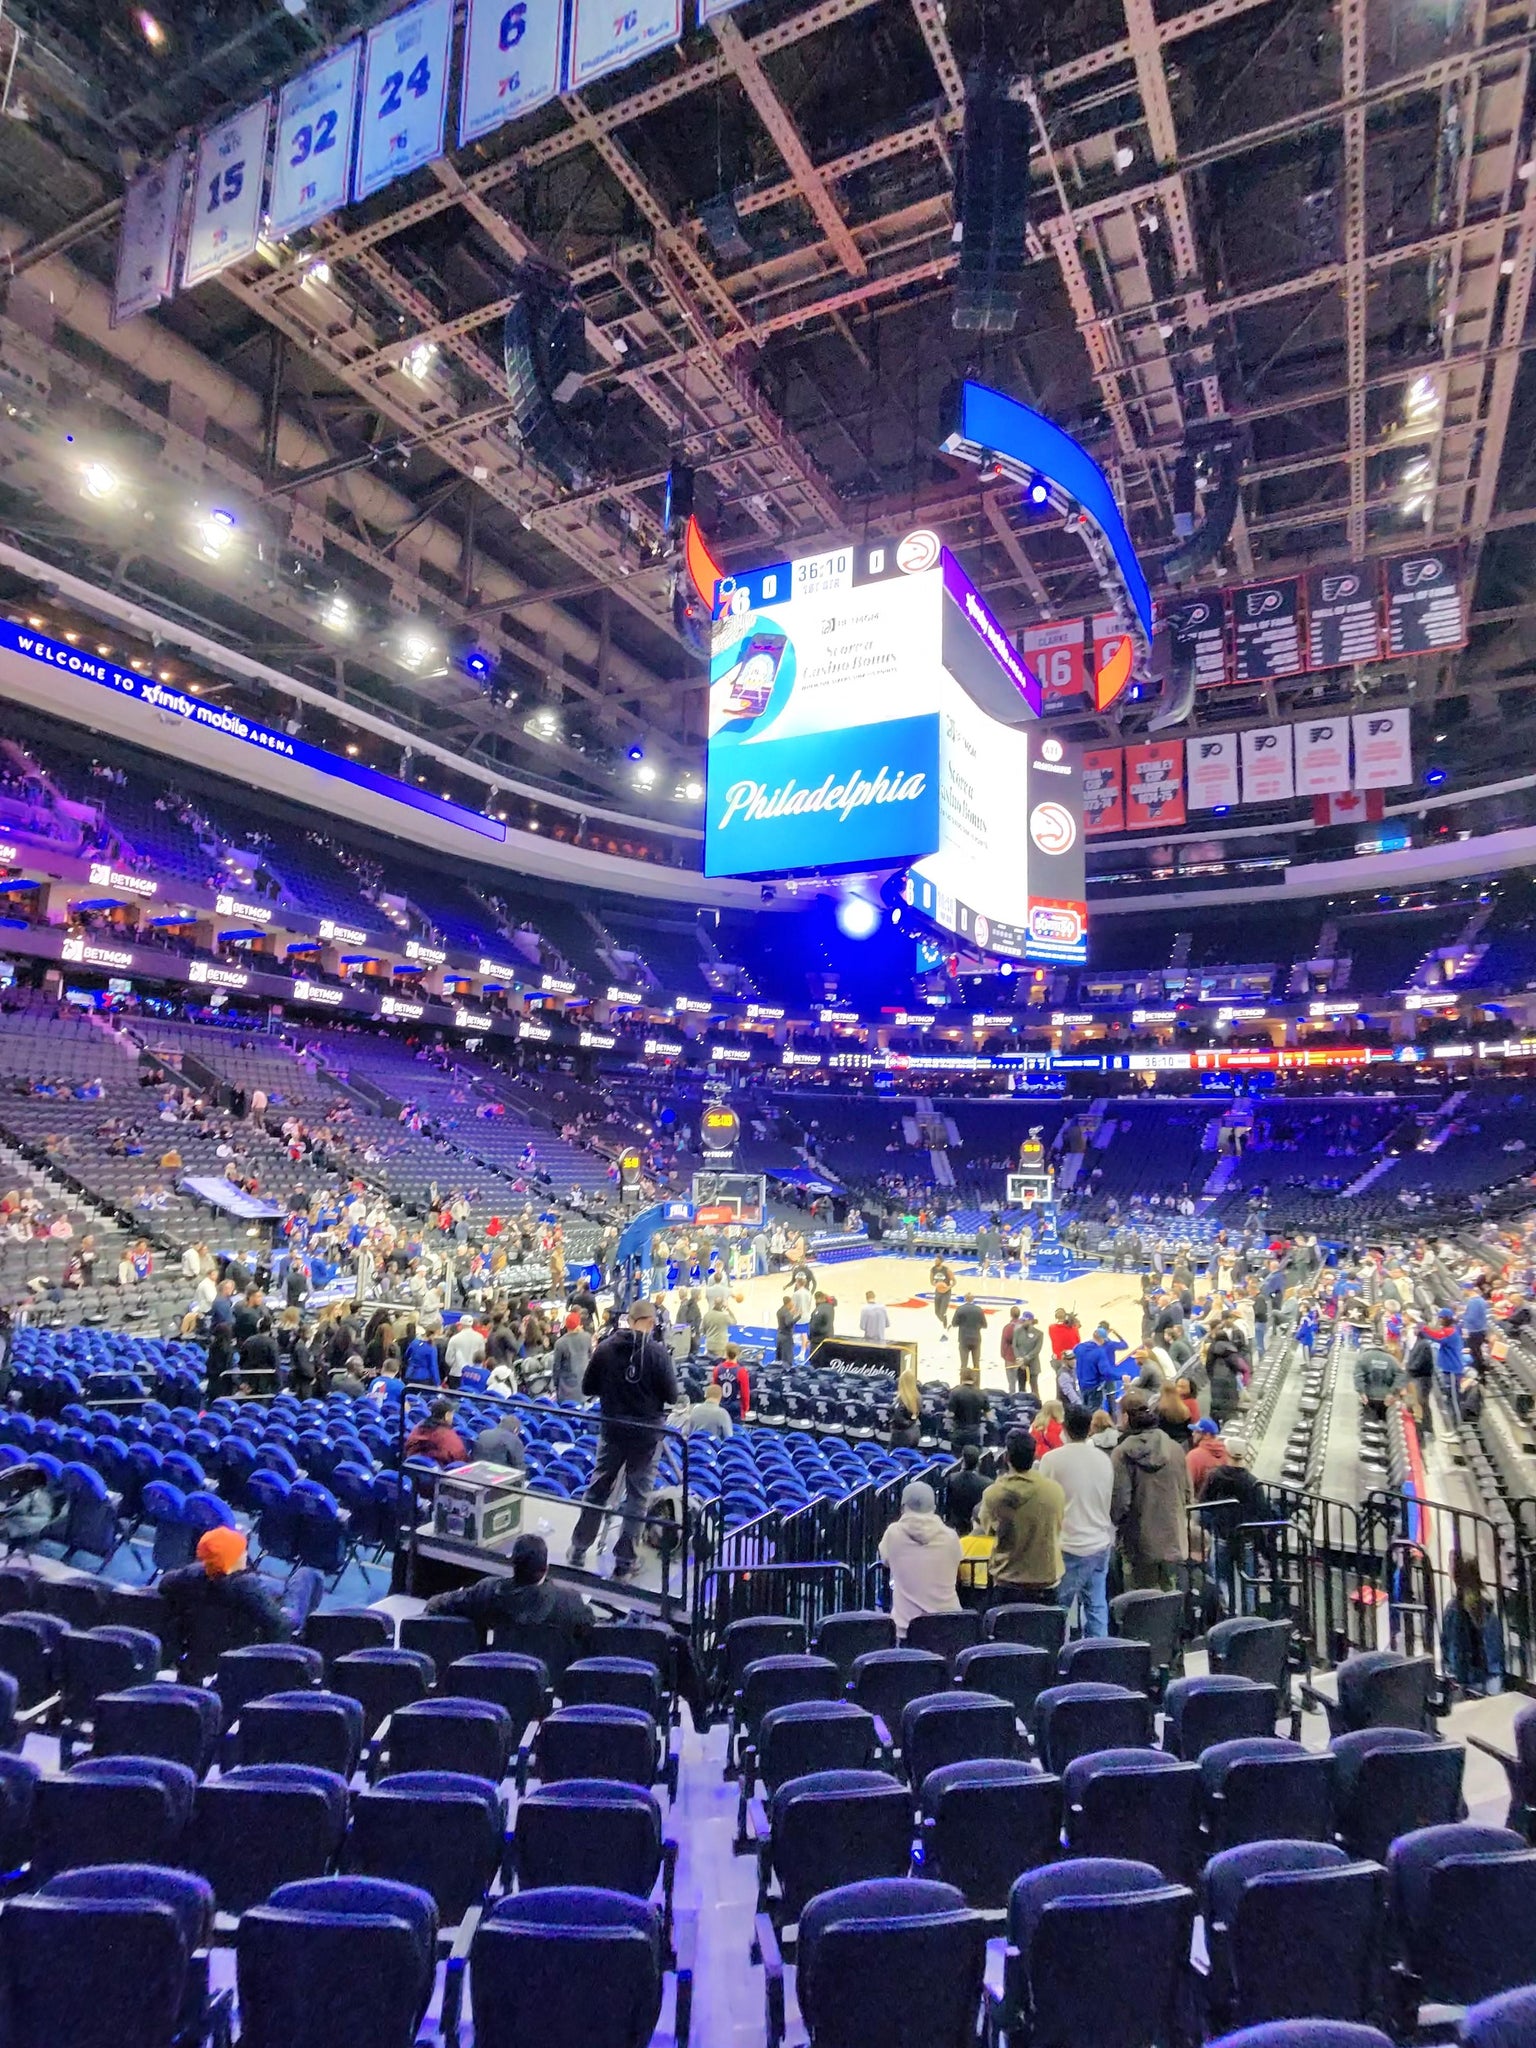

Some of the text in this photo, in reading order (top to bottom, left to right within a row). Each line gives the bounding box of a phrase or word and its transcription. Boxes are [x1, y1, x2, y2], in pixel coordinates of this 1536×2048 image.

[498, 2, 527, 53] 6
[613, 9, 638, 36] 76
[377, 53, 431, 120] 24
[498, 70, 520, 97] 76
[289, 108, 339, 168] 32
[206, 159, 246, 215] 15
[798, 555, 847, 582] 36:10
[762, 574, 778, 600] 0
[1036, 650, 1072, 688] 16
[18, 635, 295, 756] WELCOME TO xfinity mobile ARENA
[718, 765, 926, 830] Philadelphia
[110, 872, 158, 893] BETMGM
[233, 902, 271, 921] BETMGM
[334, 926, 367, 944] BETMGM
[84, 949, 133, 965] BETMGM
[418, 947, 446, 961] BETMGM
[207, 969, 248, 985] BETMGM
[489, 965, 515, 979] BETMGM
[309, 987, 344, 1002] BETMGM
[551, 979, 576, 992] BETMGM
[617, 991, 642, 1003] BETMGM
[686, 1000, 712, 1011] BETMGM
[394, 1002, 424, 1015] BETMGM
[467, 1015, 492, 1028] BETMGM
[529, 1028, 552, 1039] BETMGM
[589, 1036, 616, 1047] BETMGM
[656, 1044, 682, 1053] BETMGM
[829, 1358, 897, 1379] Philadelphia
[721, 1381, 733, 1399] 0
